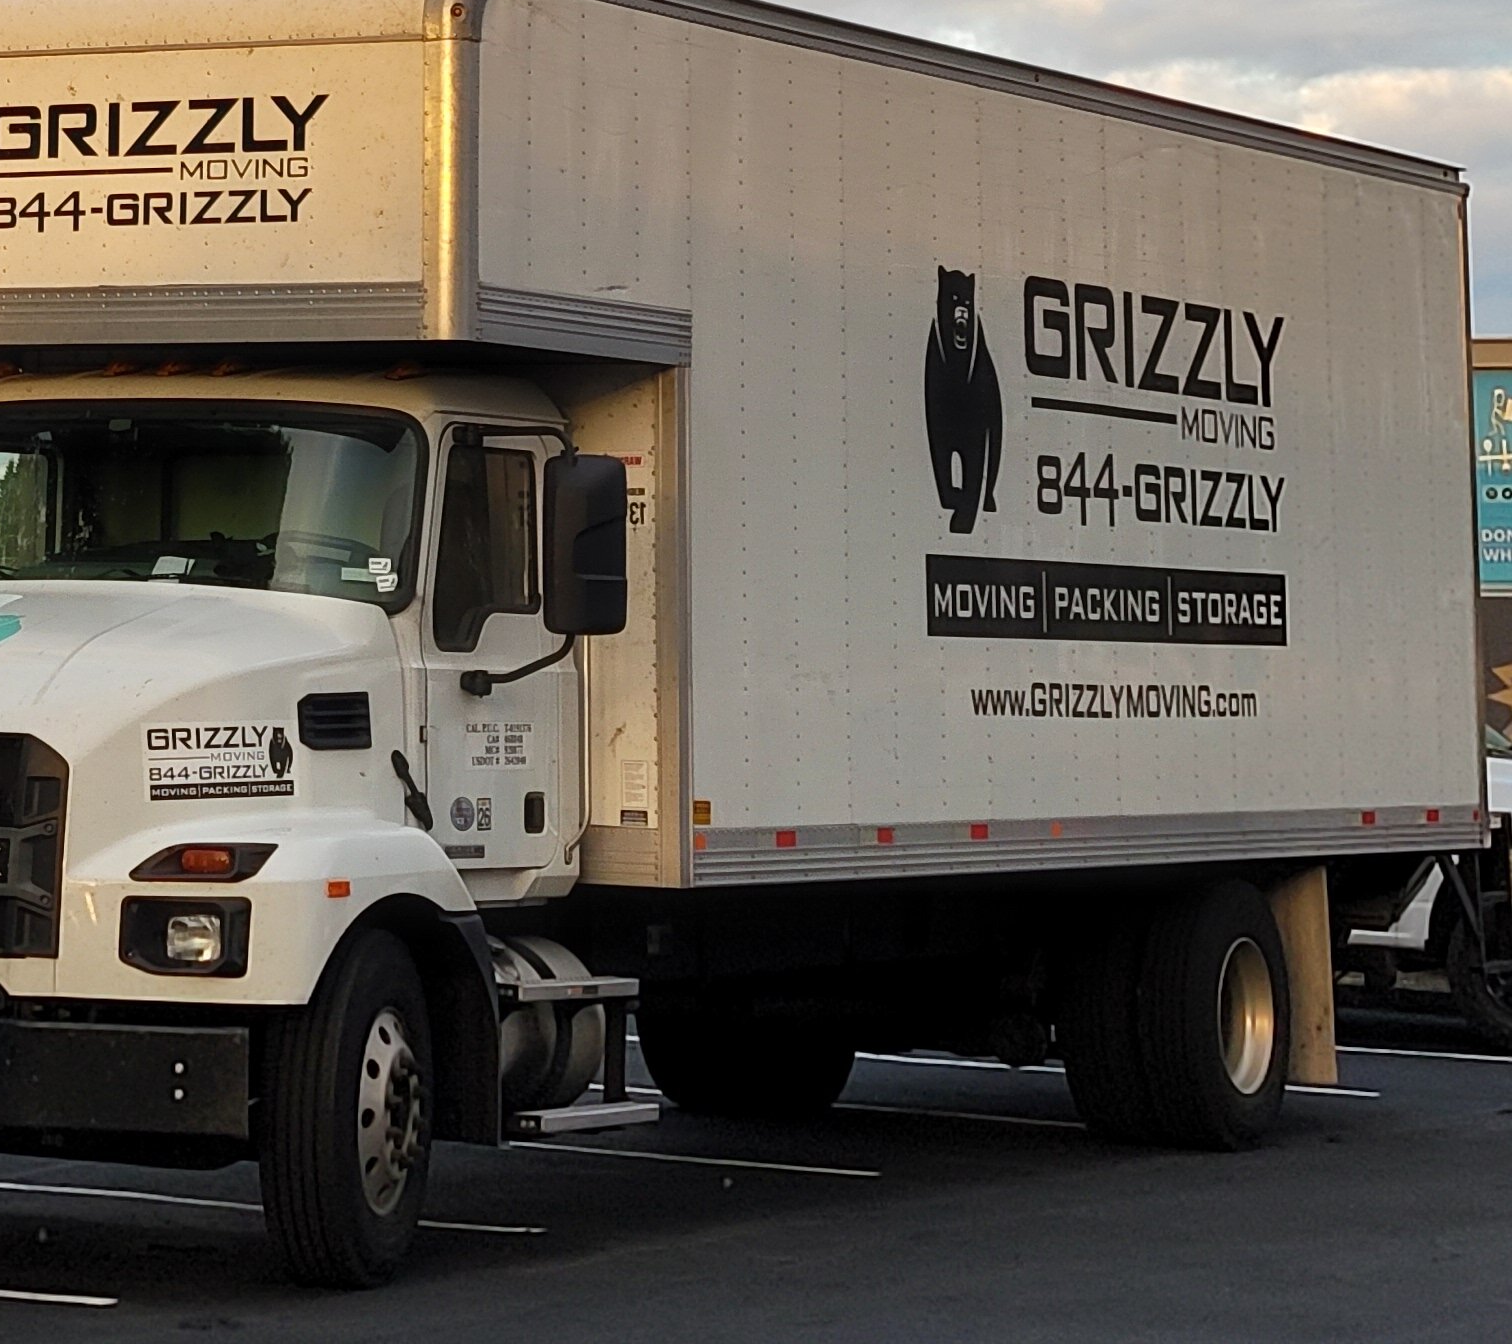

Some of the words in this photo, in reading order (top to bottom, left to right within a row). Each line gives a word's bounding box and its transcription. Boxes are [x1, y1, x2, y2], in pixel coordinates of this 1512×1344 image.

[179, 157, 310, 180] MOVING
[1023, 275, 1285, 408] GRIZZLY
[1180, 406, 1276, 451] MOVING
[1036, 451, 1285, 533] 844-GRIZZLY
[934, 583, 1035, 619] MOVING
[1054, 587, 1160, 622] PACKING
[1177, 591, 1283, 626] STORAGE
[971, 682, 1257, 719] www.GRIZZLYMOVING.com
[146, 725, 268, 750] GRIZZLY
[210, 750, 265, 762] MOVING
[149, 764, 269, 781] 844-GRIZZLY
[151, 787, 197, 797] MOVING
[202, 784, 248, 795] PACKING
[251, 783, 293, 793] STORAGE
